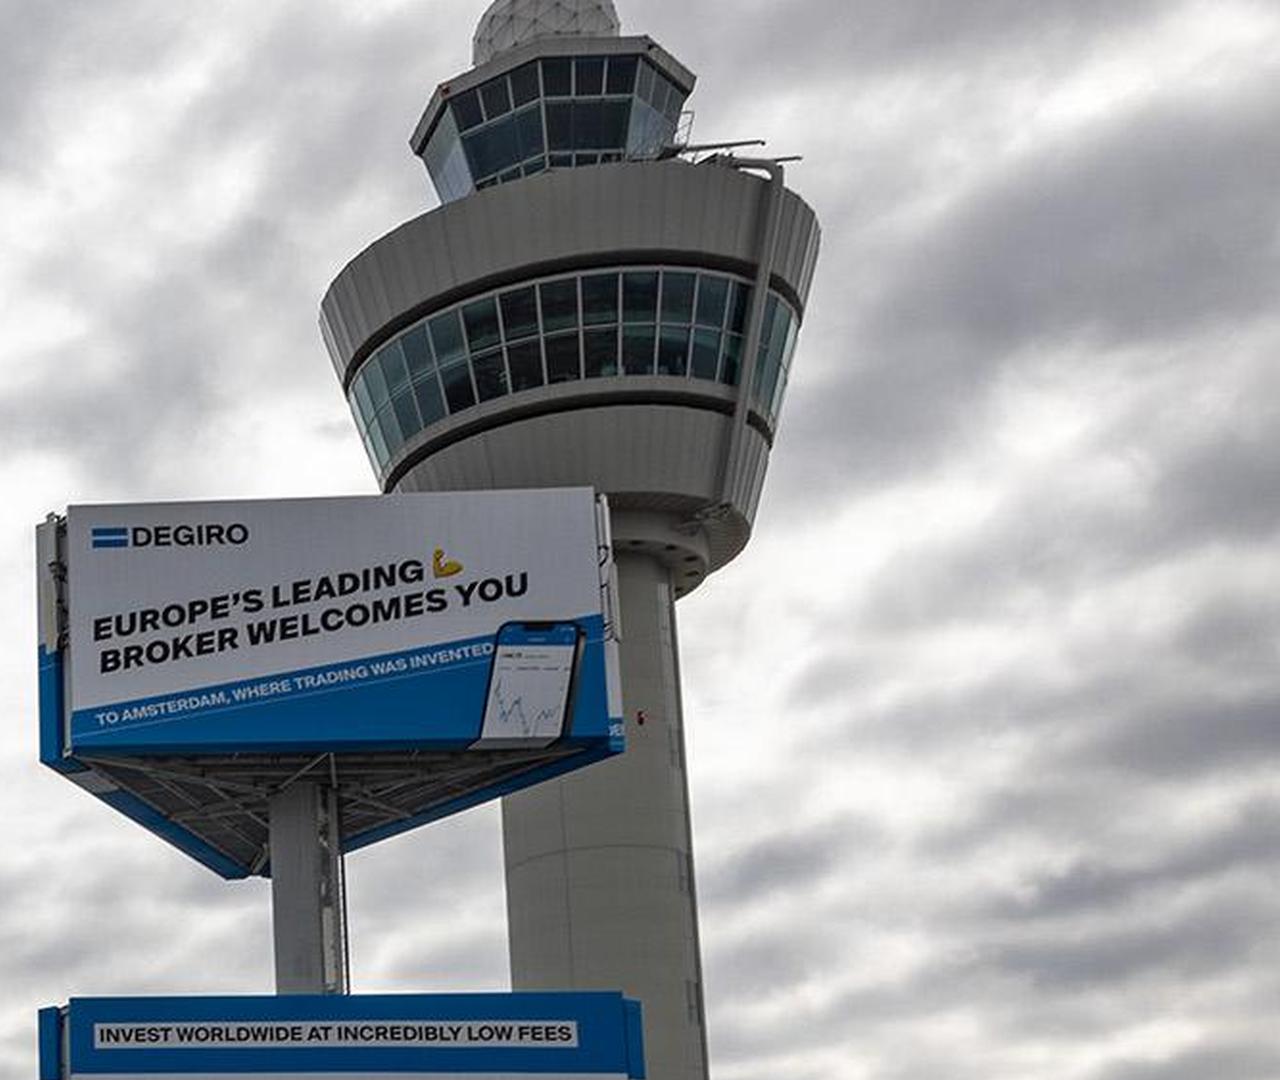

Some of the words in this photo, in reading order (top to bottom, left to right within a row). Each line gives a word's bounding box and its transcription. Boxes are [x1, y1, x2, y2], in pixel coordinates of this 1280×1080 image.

[132, 524, 249, 547] DEGIRO
[272, 559, 424, 607] LEADING
[100, 627, 239, 674] BROKER
[247, 588, 448, 646] WELCOMES
[455, 572, 529, 607] YOU
[95, 711, 119, 726] TO
[122, 691, 231, 722] AMSTERDAM,
[232, 679, 292, 702] WHERE
[291, 665, 369, 690] TRADING
[370, 657, 408, 676] WAS
[410, 643, 494, 669] INVENTED
[99, 1027, 173, 1043] INVEST
[176, 1026, 303, 1043] WORLDWIDE
[307, 1026, 332, 1041] AT
[338, 1026, 462, 1041] INCREDIBLY
[467, 1026, 514, 1041] LOW
[518, 1025, 573, 1041] FEES
